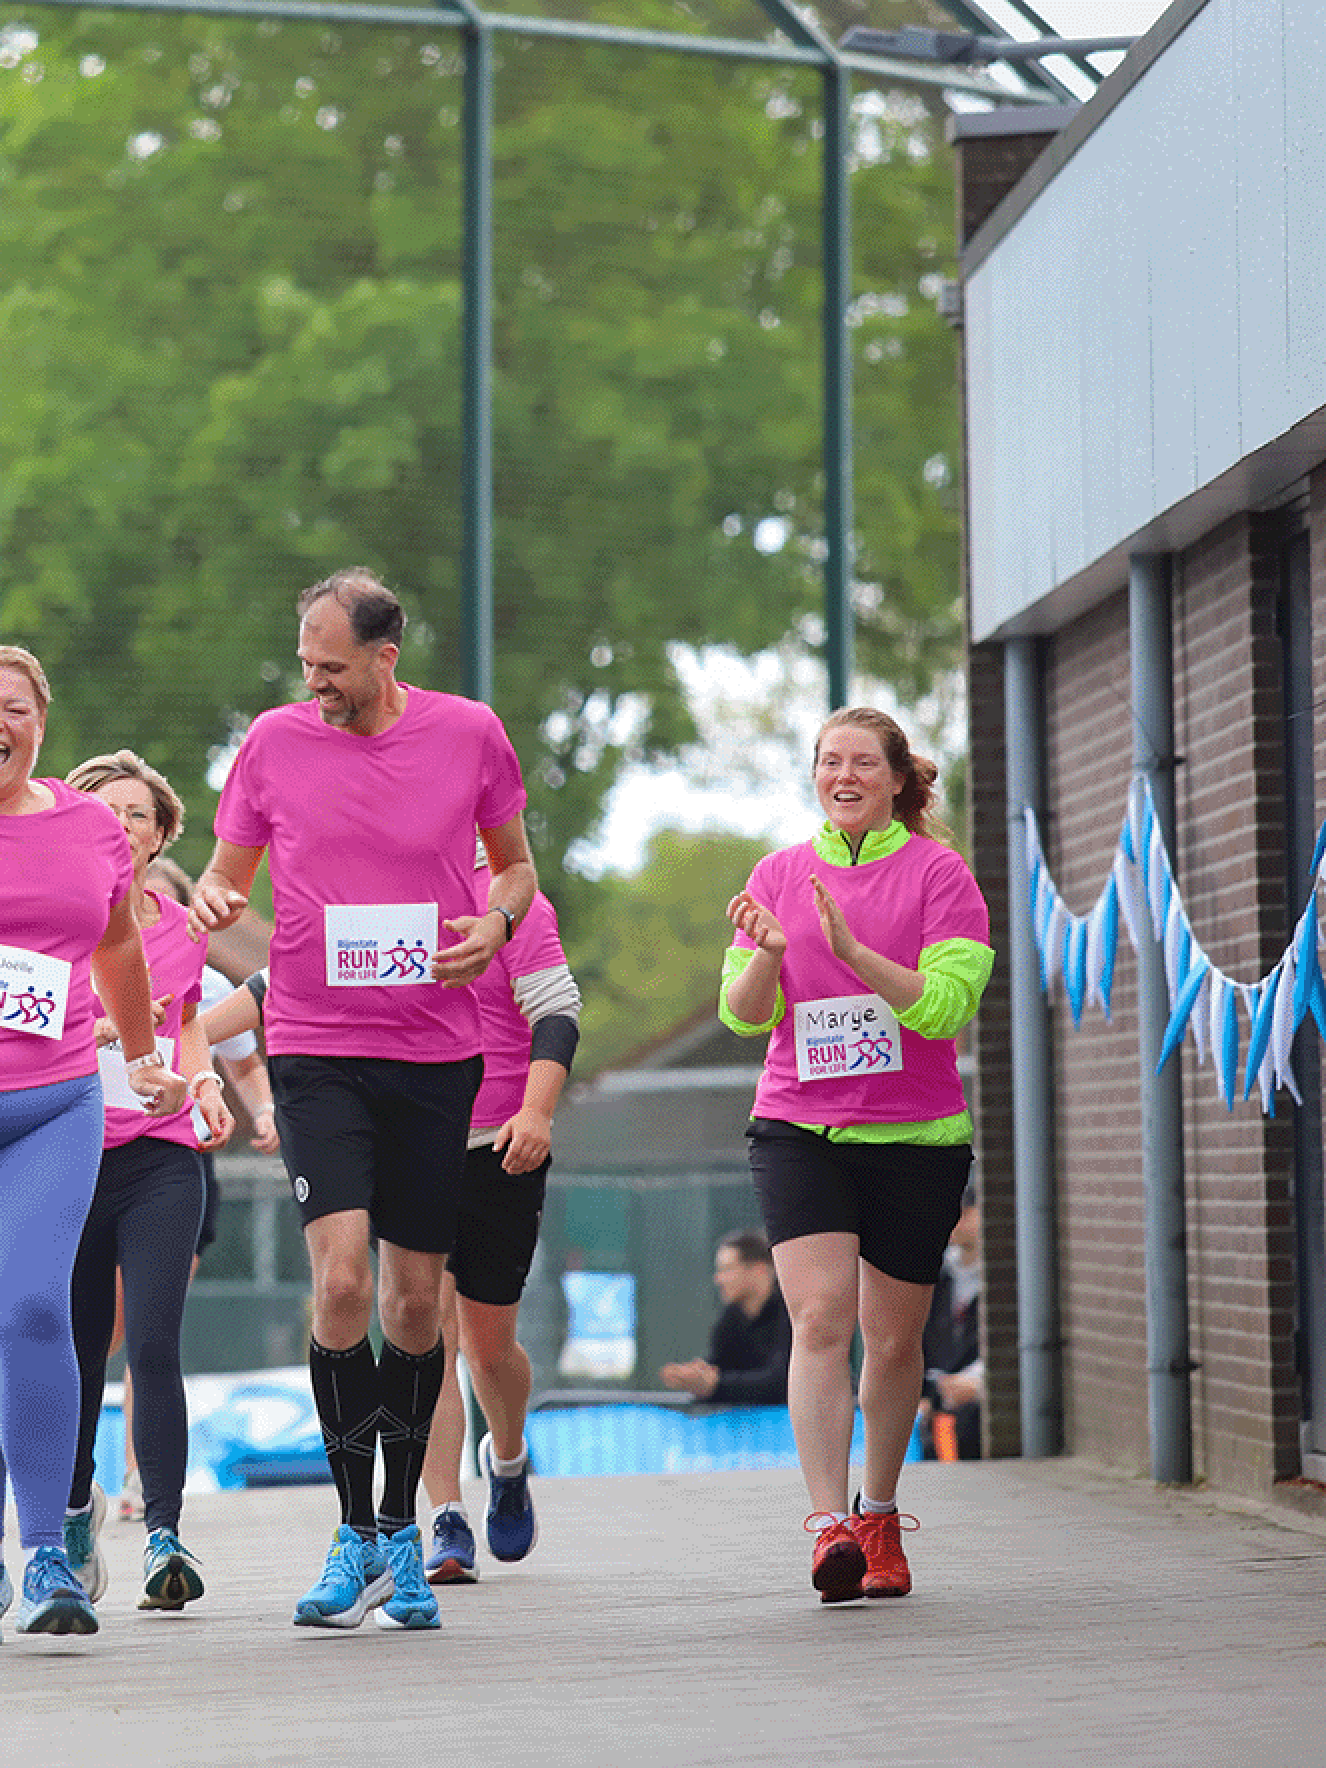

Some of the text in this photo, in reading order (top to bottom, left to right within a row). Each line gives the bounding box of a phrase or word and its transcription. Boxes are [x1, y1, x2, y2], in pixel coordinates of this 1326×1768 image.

[337, 949, 378, 969] RUN
[337, 969, 377, 980] FOR LIFE
[807, 1043, 847, 1065] RUN
[810, 1063, 847, 1075] FOR LIFE
